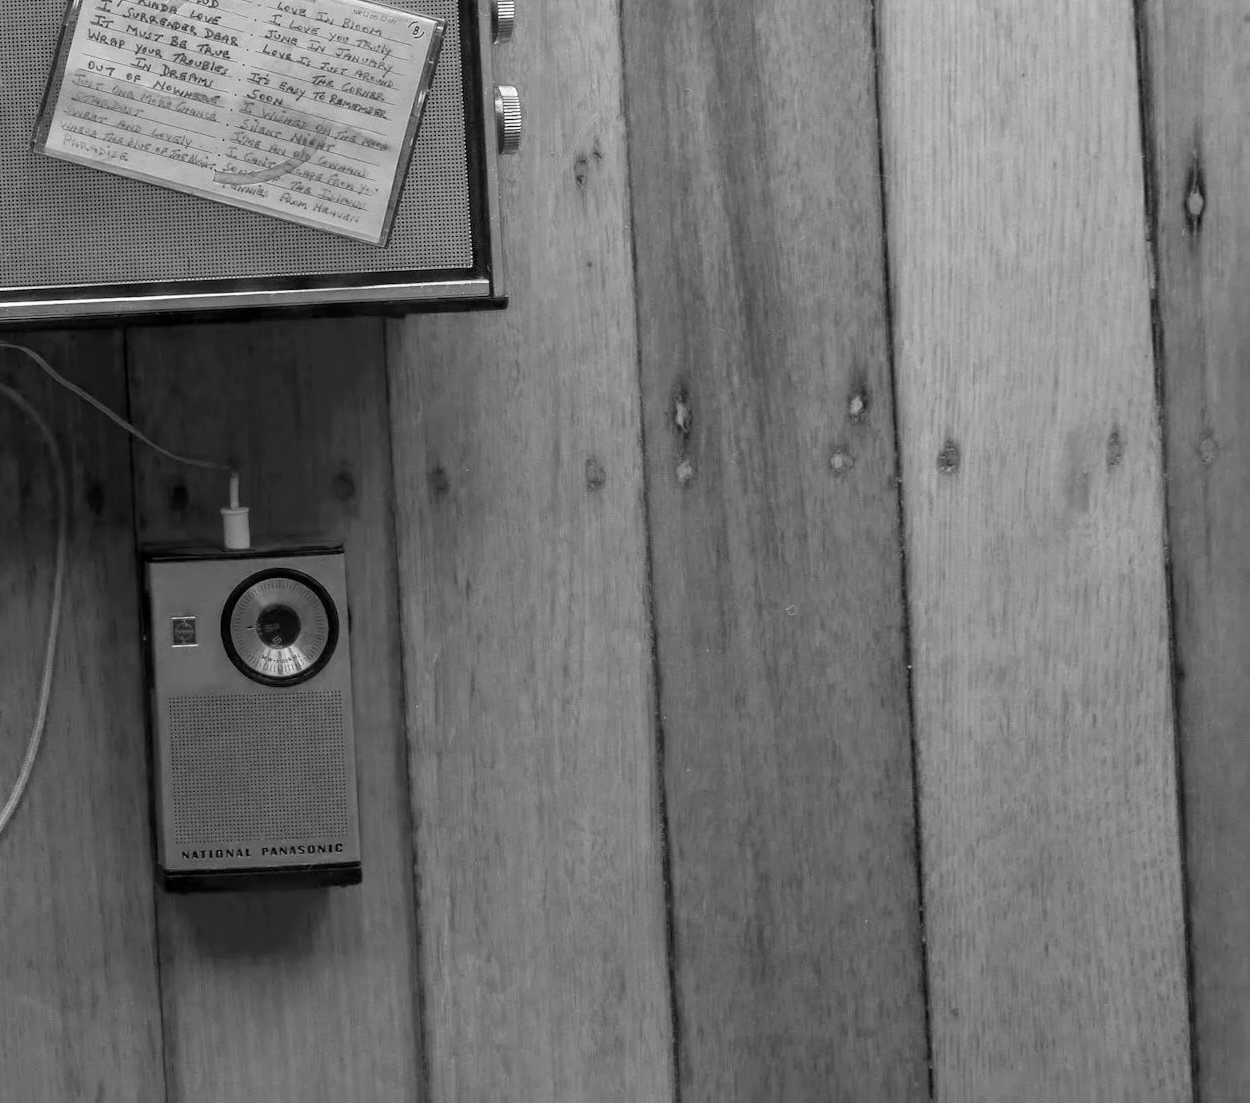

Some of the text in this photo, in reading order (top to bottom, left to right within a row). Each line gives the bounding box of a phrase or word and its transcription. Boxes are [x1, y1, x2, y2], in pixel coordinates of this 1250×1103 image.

[190, 9, 221, 26] LOVE
[277, 1, 307, 18] LOVE
[317, 11, 335, 26] IN
[89, 14, 231, 60] IT MUST BE TRUE
[123, 6, 198, 37] SURRENDER
[204, 27, 239, 47] DEAR
[268, 13, 283, 27] I
[289, 19, 321, 37] LOVE
[328, 30, 350, 43] YOU
[88, 27, 126, 49] WRAP
[134, 43, 163, 59] YOUR
[262, 43, 293, 63] LOVE
[263, 29, 394, 79] JUNE IN JANUARY
[88, 60, 116, 77] OUT
[126, 72, 142, 83] OF
[129, 57, 214, 89] IN DREAMS
[311, 74, 335, 88] THE
[111, 84, 136, 101] ONE
[245, 89, 284, 107] SOON
[279, 81, 306, 102] EASY
[312, 91, 326, 101] TO
[117, 119, 143, 134] AND
[181, 843, 344, 860] NATIONAL PANASONIC
